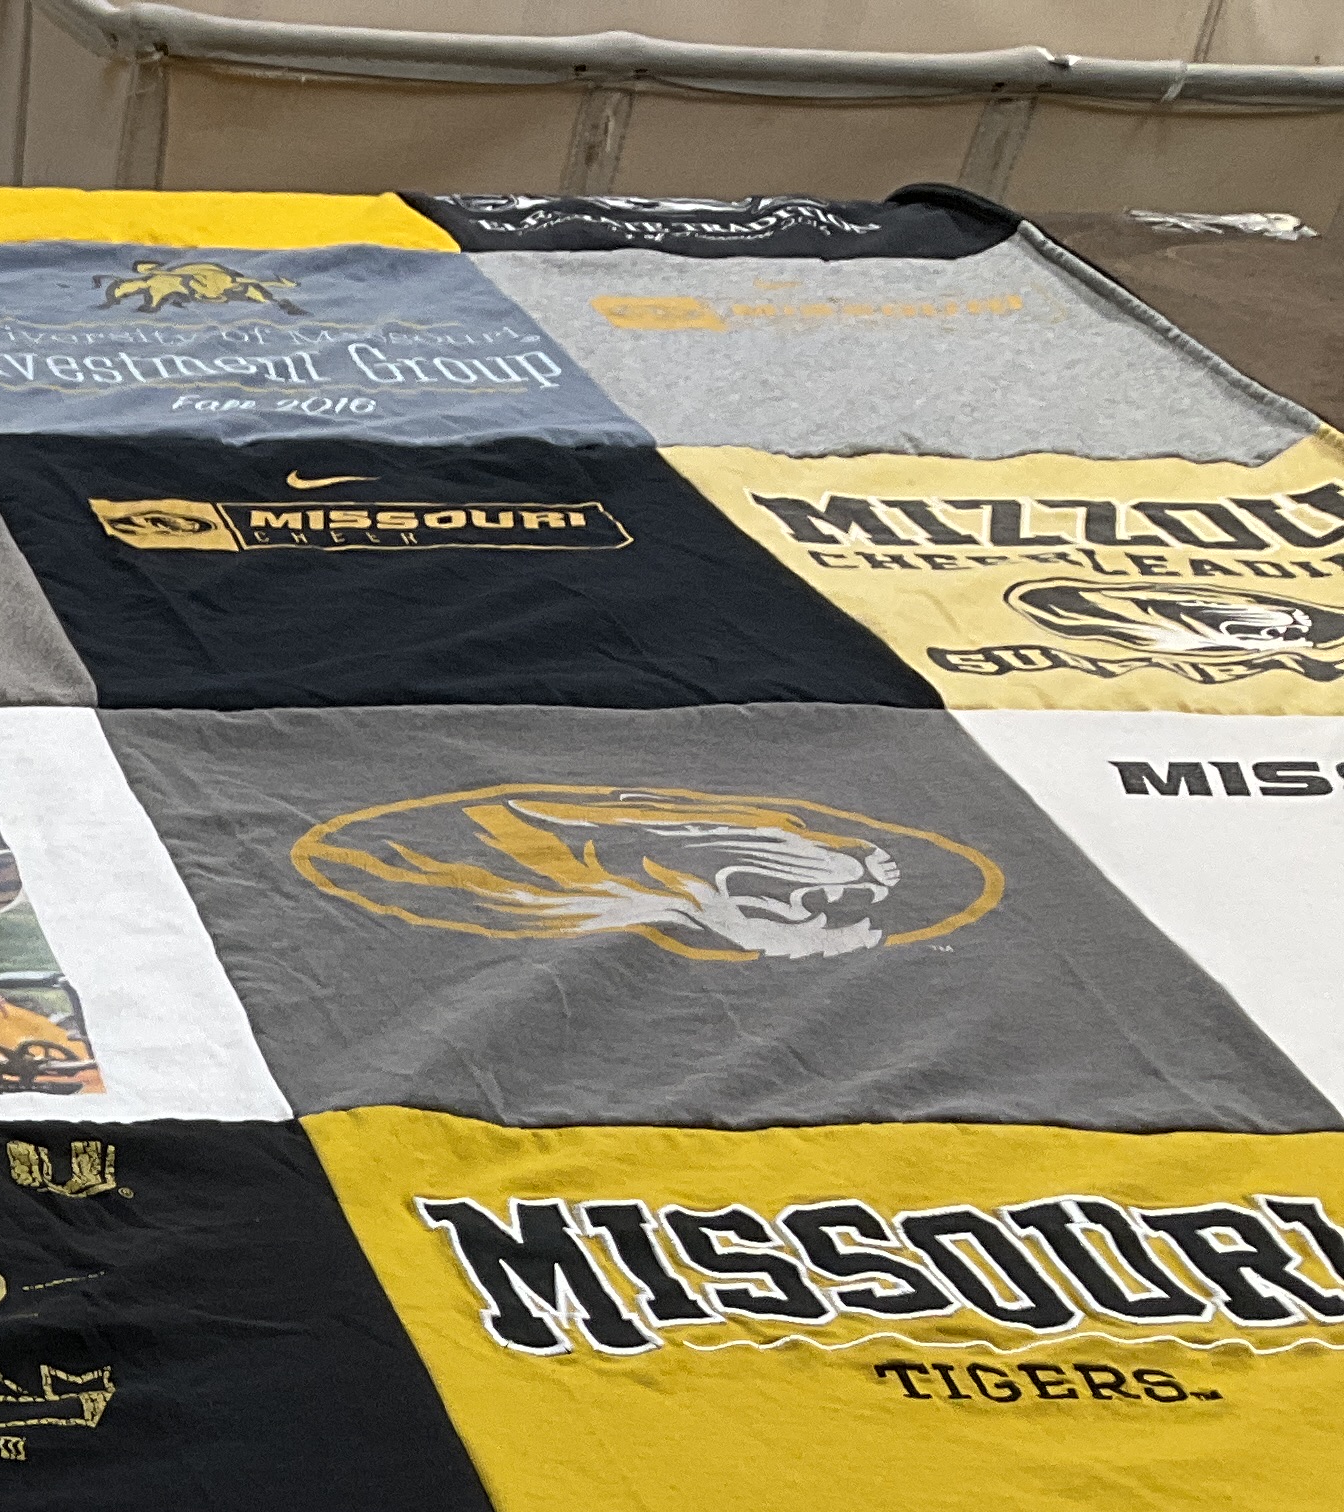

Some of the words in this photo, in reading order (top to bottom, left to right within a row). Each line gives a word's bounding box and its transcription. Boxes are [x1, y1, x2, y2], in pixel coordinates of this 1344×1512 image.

[347, 342, 562, 388] Group
[249, 508, 588, 531] MISSOURI
[253, 530, 419, 545] CHEER
[746, 480, 1344, 549] MIZZOU
[413, 1194, 1344, 1357] MISSOURI
